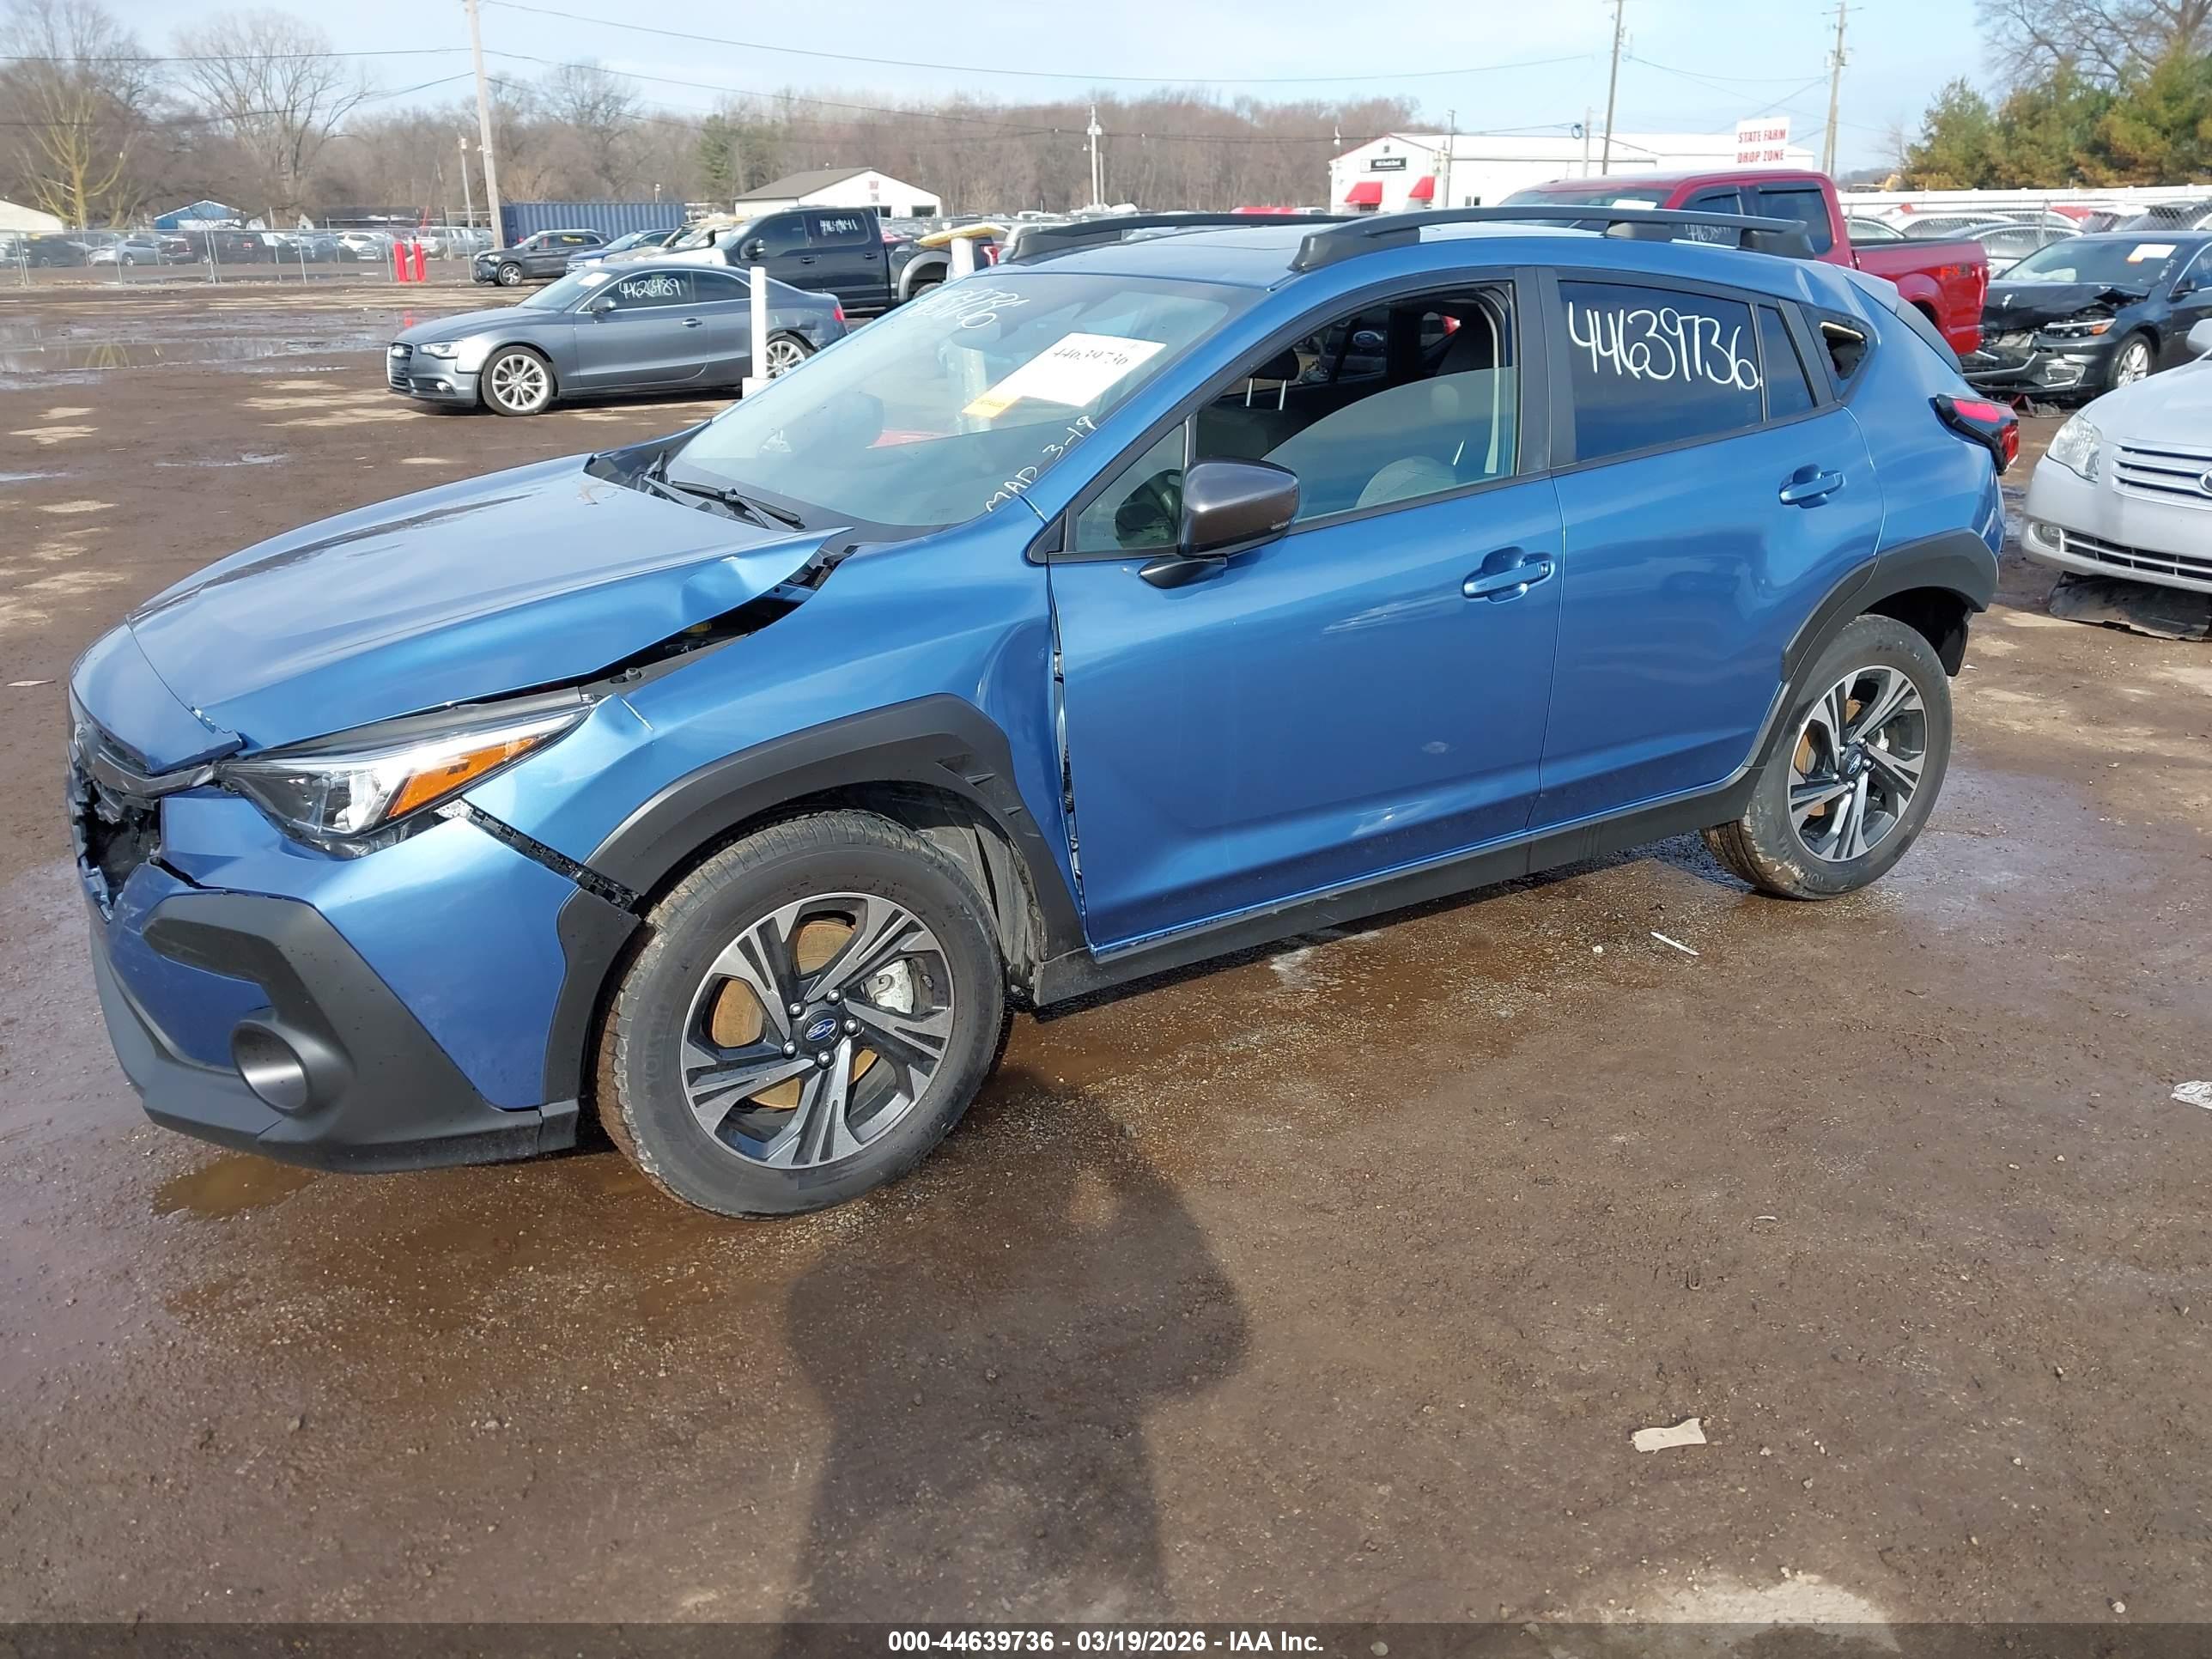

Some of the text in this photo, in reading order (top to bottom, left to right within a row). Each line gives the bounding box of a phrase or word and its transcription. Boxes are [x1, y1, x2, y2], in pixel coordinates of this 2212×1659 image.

[1738, 129, 1786, 143] STATE FARM
[1737, 149, 1785, 163] DROP ZONE
[1042, 416, 1097, 461] 3-19
